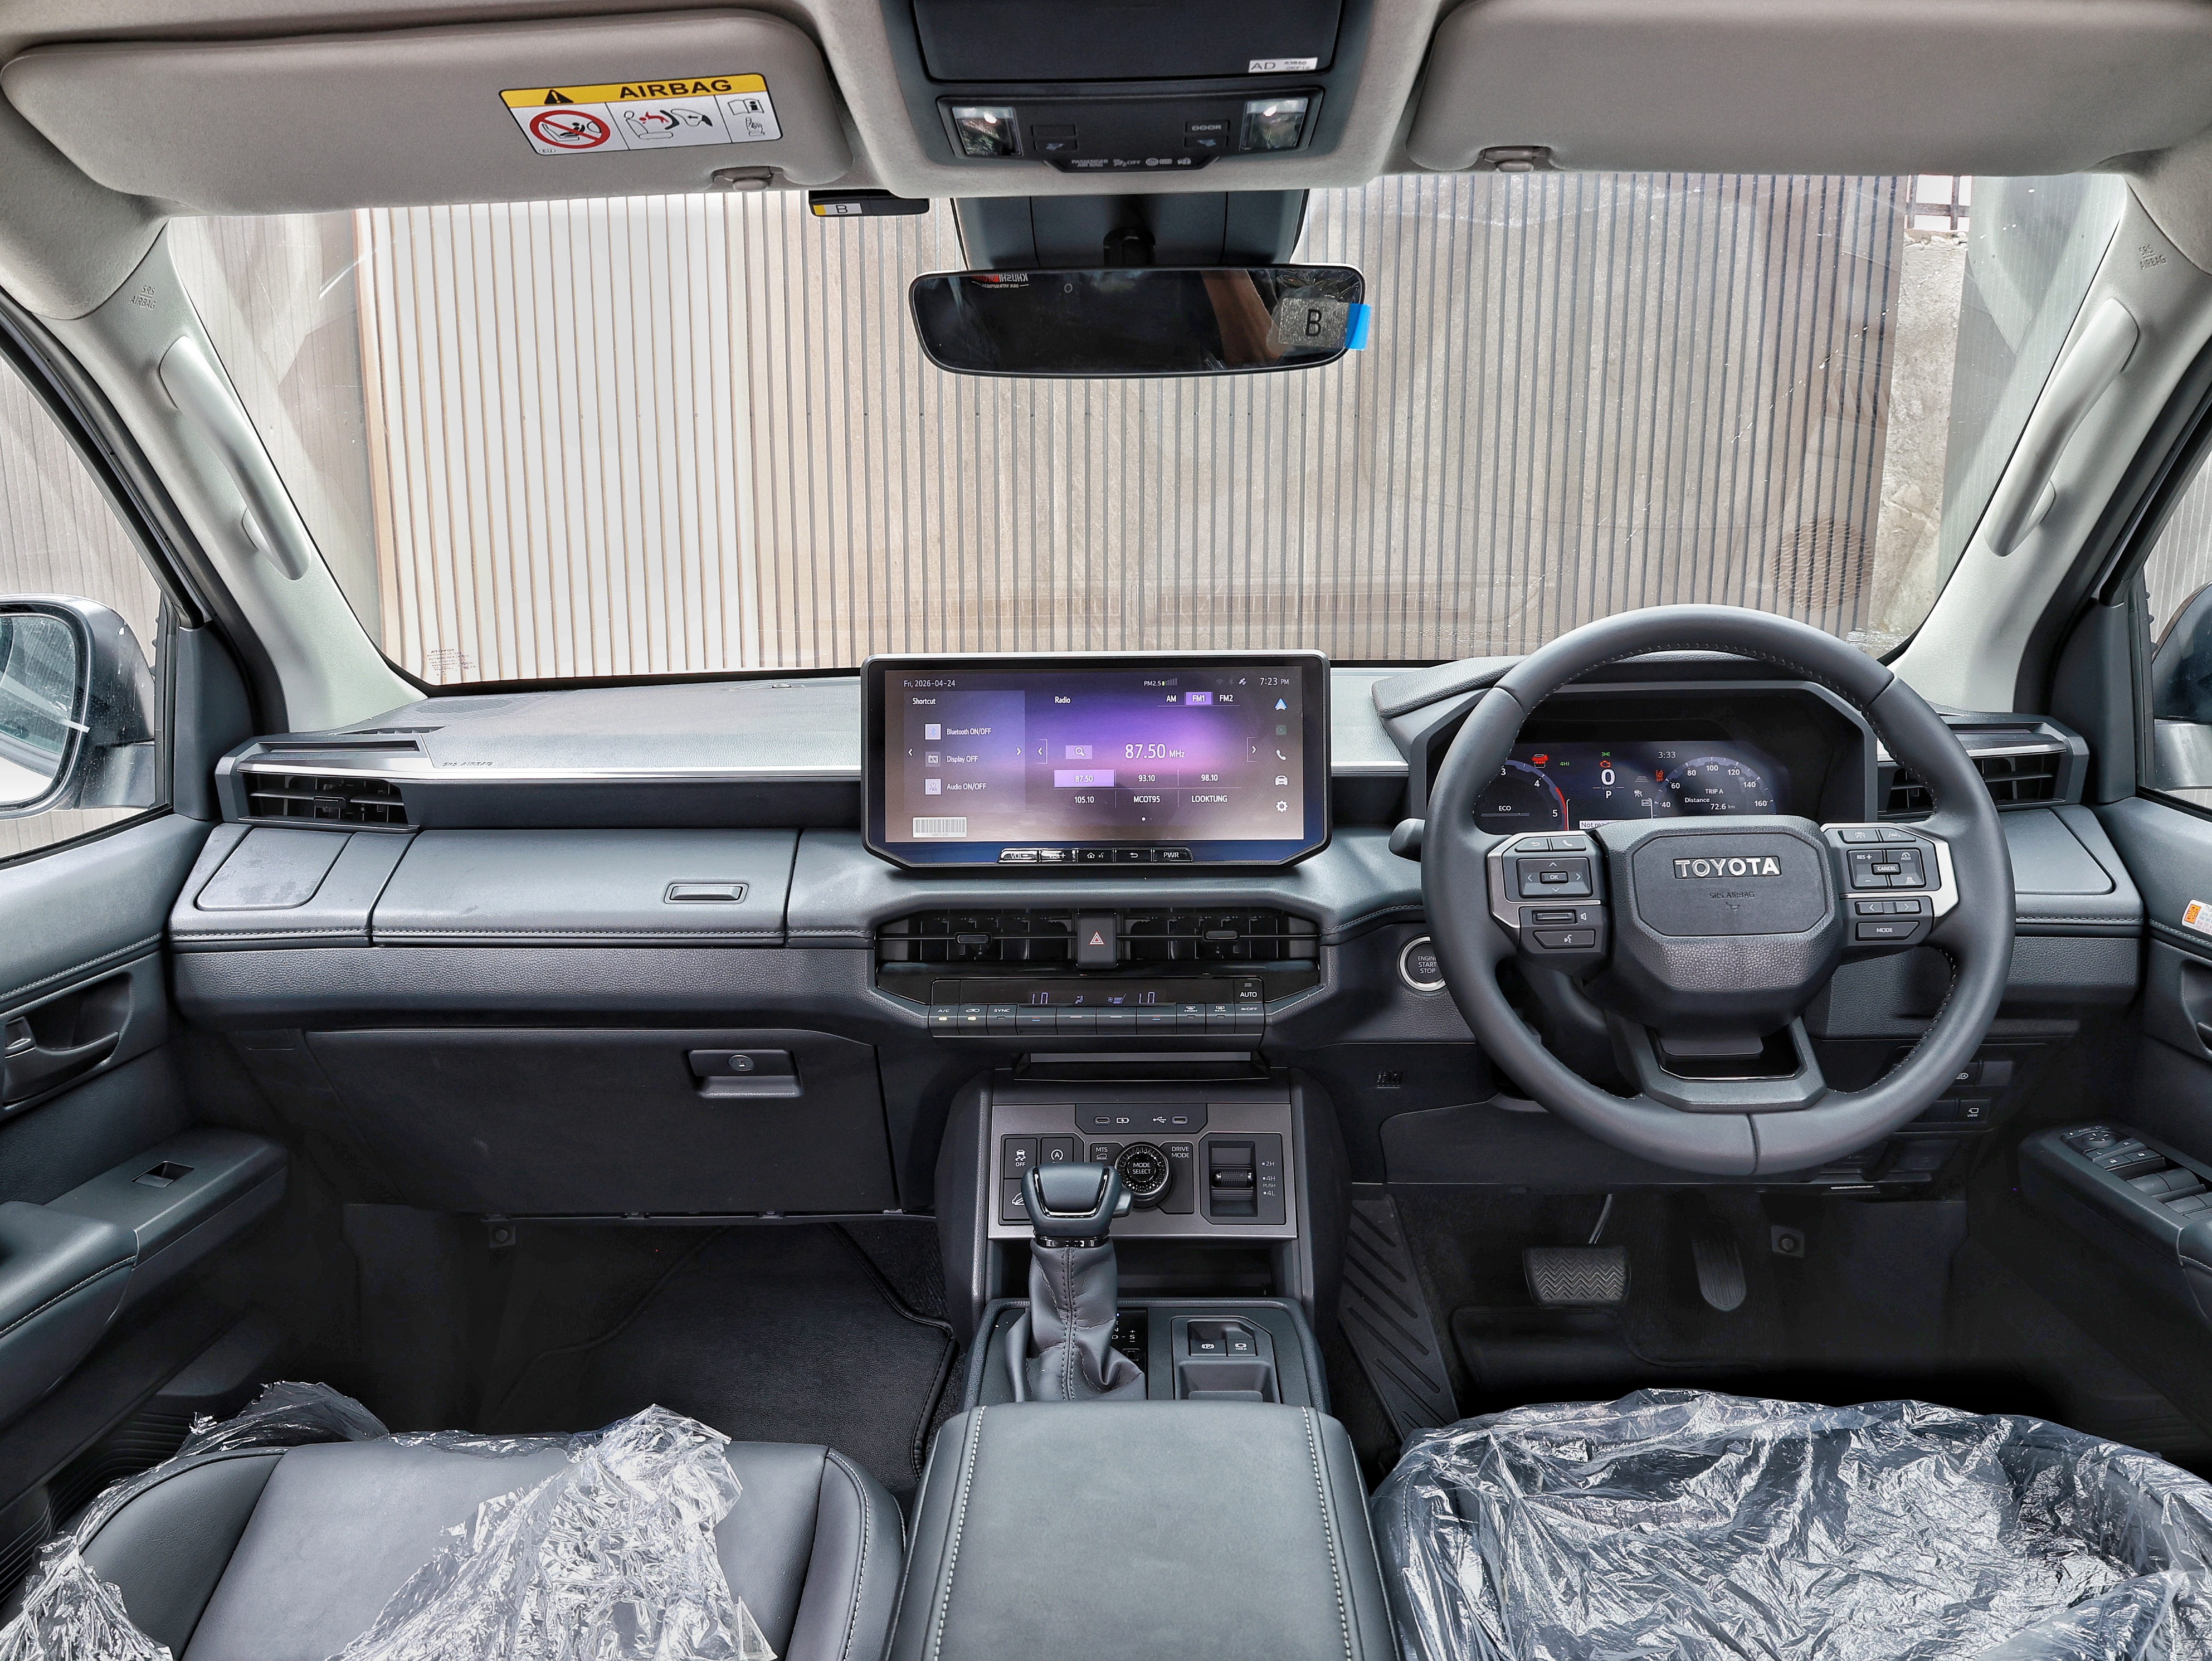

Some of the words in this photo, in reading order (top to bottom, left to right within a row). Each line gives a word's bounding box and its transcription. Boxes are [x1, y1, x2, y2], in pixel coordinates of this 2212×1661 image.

[1251, 62, 1276, 70] AD
[620, 79, 732, 99] AIRBAG
[836, 205, 848, 214] B
[2139, 244, 2154, 255] SRS
[2140, 254, 2166, 269] AIRBAG
[141, 285, 155, 295] SRS
[130, 296, 156, 310] AIRBAG
[1306, 310, 1322, 336] B
[1260, 677, 1277, 686] 7:23
[970, 727, 991, 736] ON/OFF
[1125, 743, 1166, 759] 87.50
[1169, 750, 1185, 758] MHz
[946, 755, 965, 764] Display
[1601, 769, 1615, 785] 0
[963, 782, 987, 791] ON/OFF
[1191, 795, 1228, 803] LOOKTUNG
[1675, 858, 1780, 877] TOYOTA
